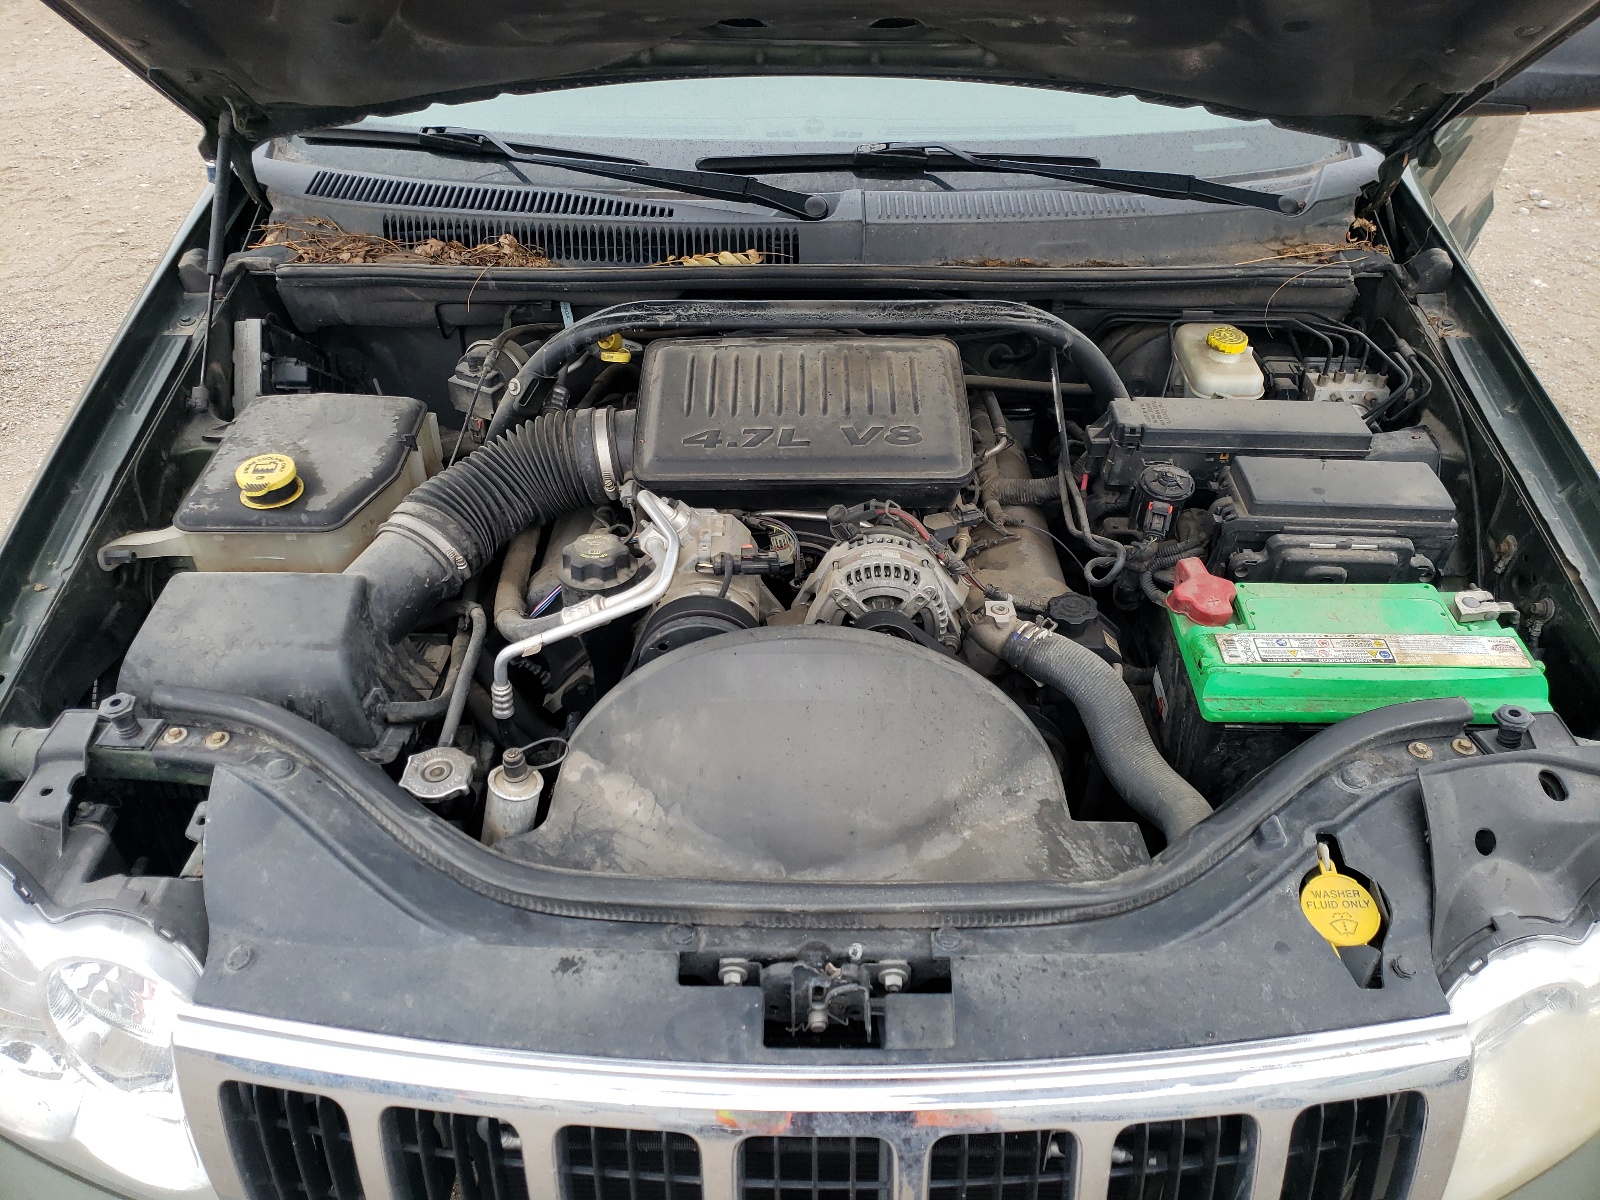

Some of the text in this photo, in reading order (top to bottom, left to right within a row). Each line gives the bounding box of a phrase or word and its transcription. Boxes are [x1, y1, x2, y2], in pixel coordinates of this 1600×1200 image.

[682, 425, 923, 449] 4.7L V8
[1311, 889, 1361, 899] WASHER
[1306, 899, 1370, 910] FLUID ONLY
